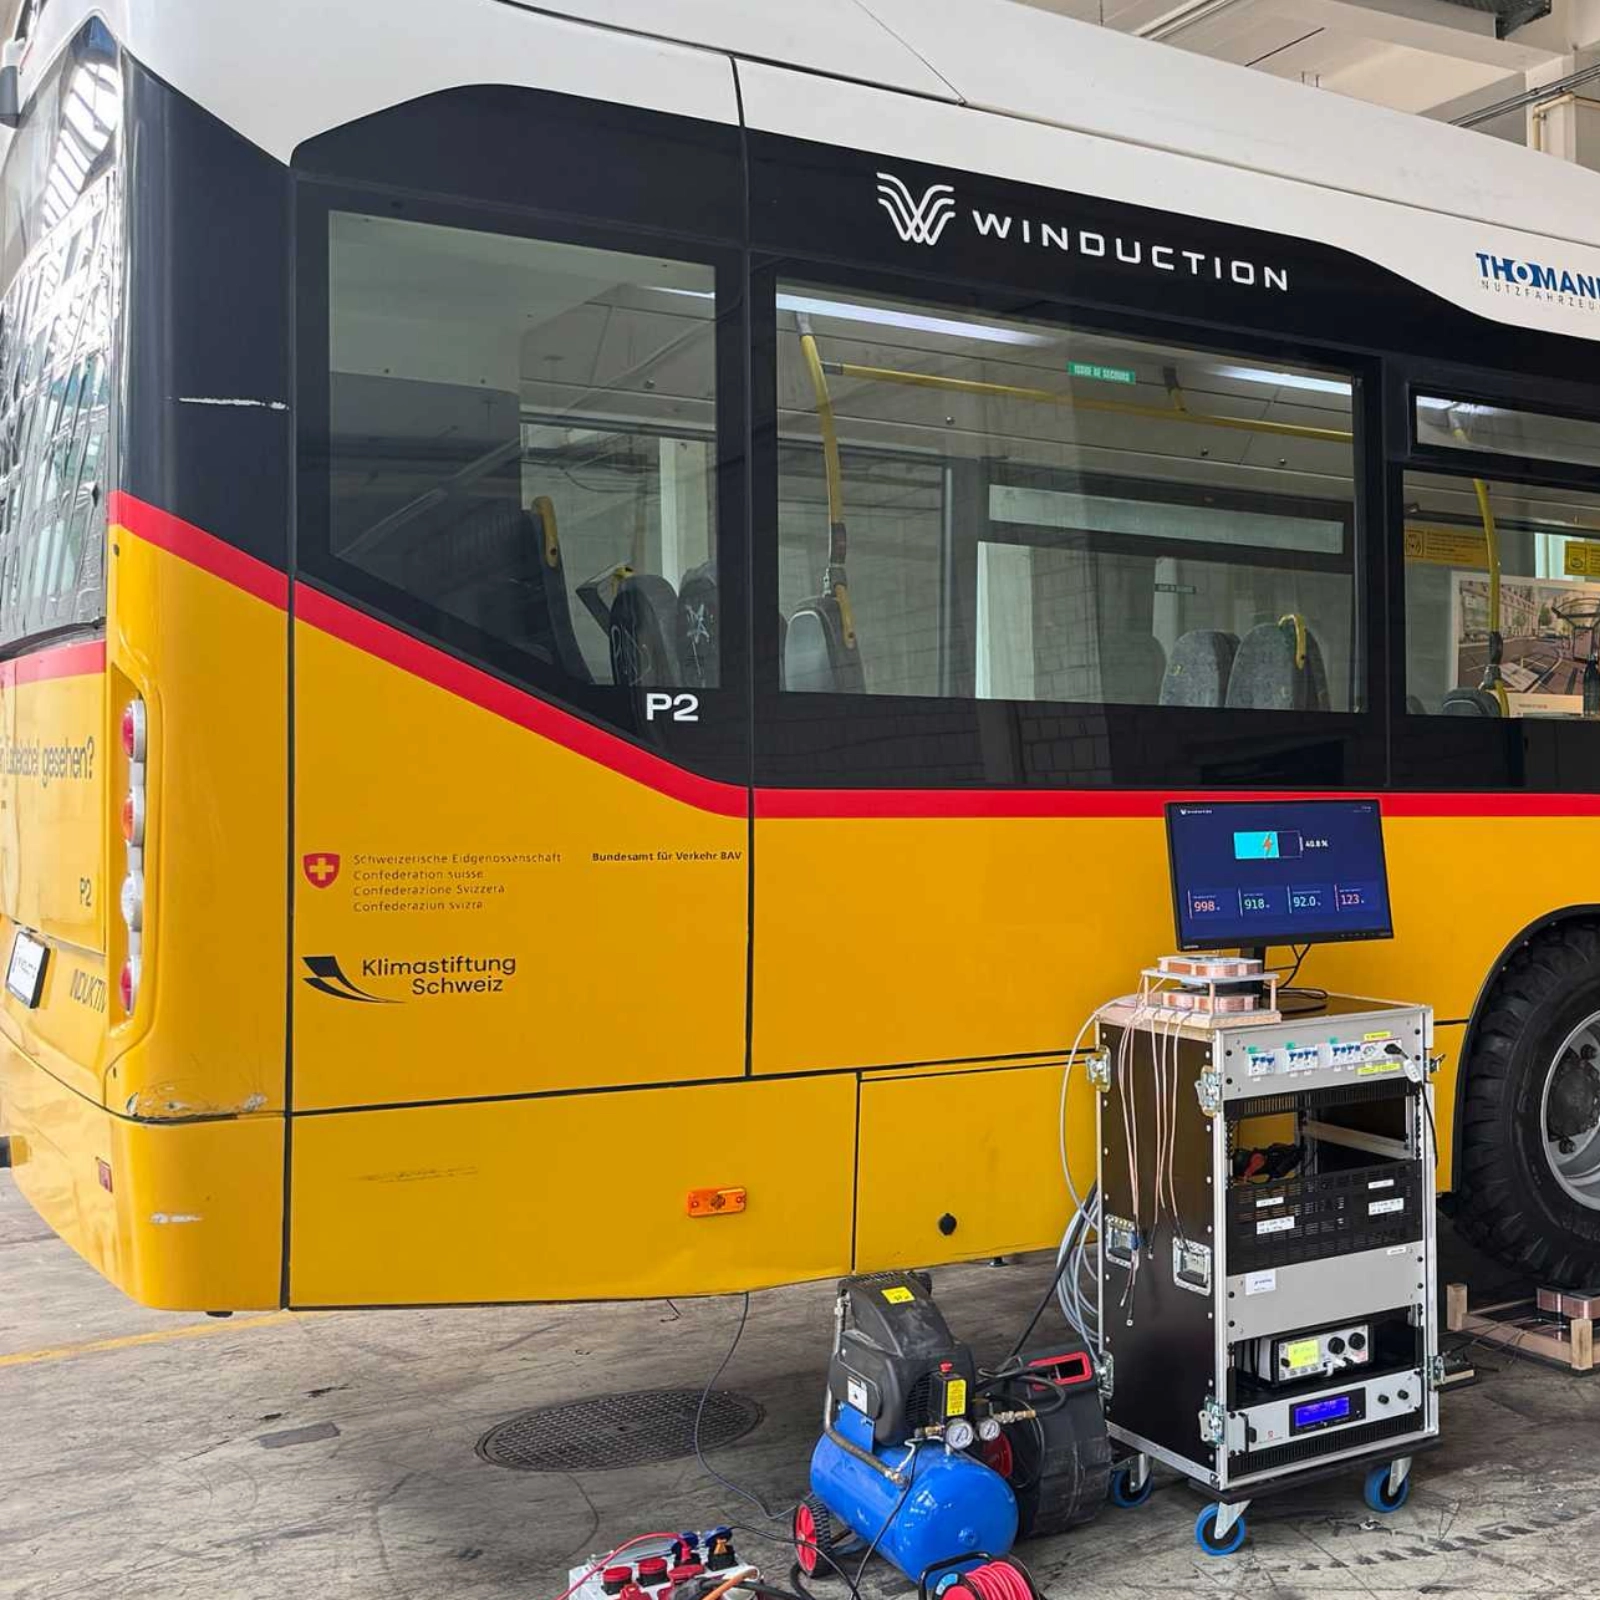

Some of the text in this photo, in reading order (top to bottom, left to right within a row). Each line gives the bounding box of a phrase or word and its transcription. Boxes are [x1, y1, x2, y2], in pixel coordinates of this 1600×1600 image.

[972, 210, 1288, 292] WINDUCTION
[646, 693, 699, 721] P2
[42, 735, 95, 789] gesehen?
[353, 853, 562, 866] Schweizerische Eidgenossenschaft
[592, 851, 742, 862] Bundesamt für Verkehr BAV
[448, 869, 484, 880] suisse
[80, 877, 92, 907] P2
[353, 883, 506, 897] Confederazione Svizzera
[353, 899, 484, 913] Confederaziun svizra
[1194, 900, 1215, 912] 998
[1244, 898, 1265, 910] 918
[1293, 896, 1316, 908] 92.0
[1341, 893, 1360, 906] 123
[362, 955, 516, 977] Klimastiftung
[412, 976, 503, 996] Schweiz
